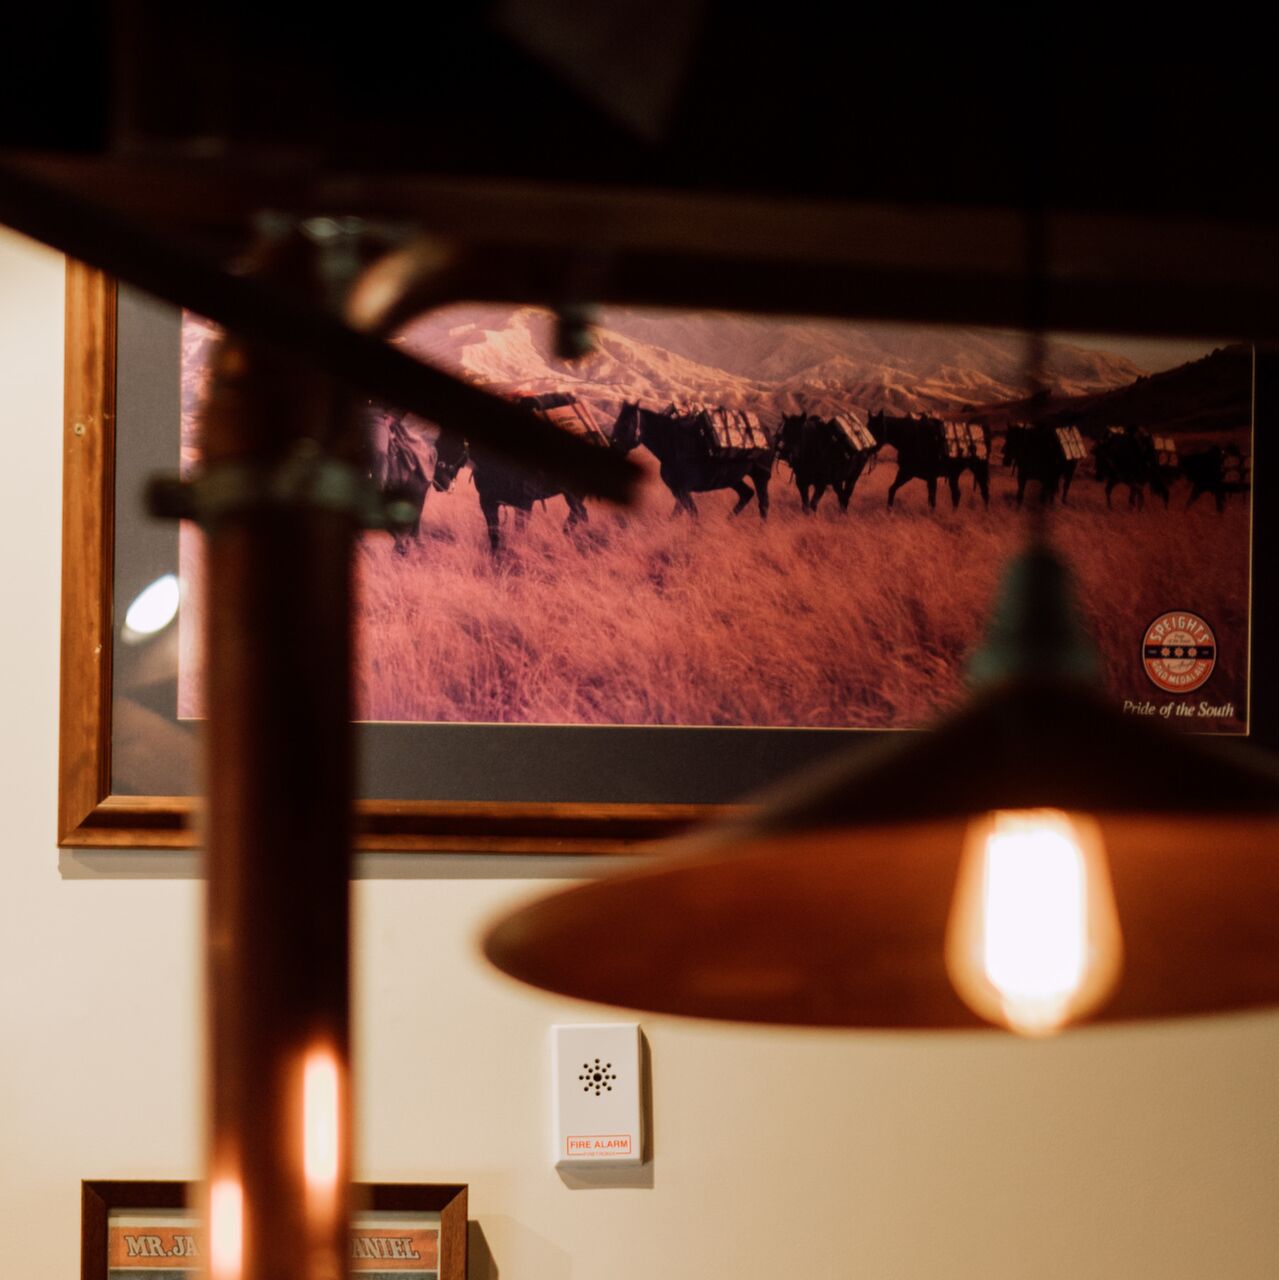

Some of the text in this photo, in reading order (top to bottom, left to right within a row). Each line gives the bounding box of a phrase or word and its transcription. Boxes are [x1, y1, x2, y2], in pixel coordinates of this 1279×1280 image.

[1122, 700, 1235, 719] Pride of the South
[569, 1139, 629, 1149] FIRE ALARM
[351, 1236, 421, 1260] ANIEL
